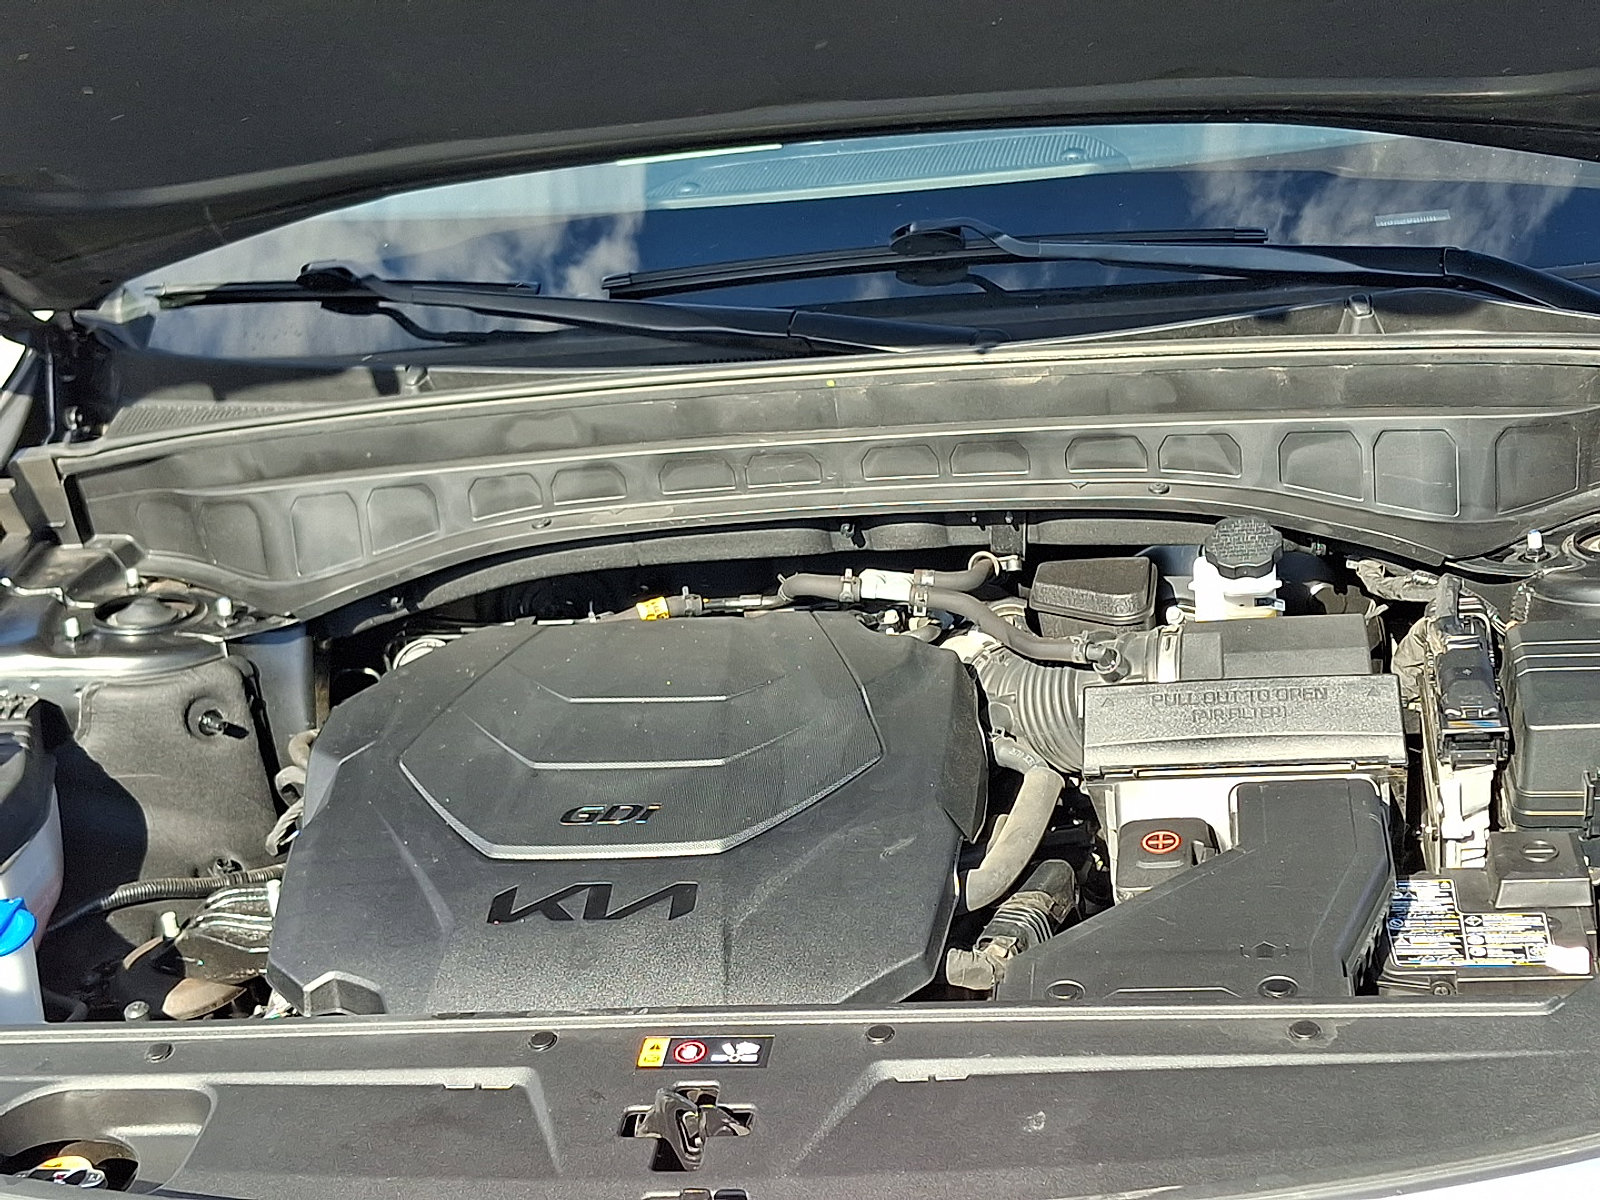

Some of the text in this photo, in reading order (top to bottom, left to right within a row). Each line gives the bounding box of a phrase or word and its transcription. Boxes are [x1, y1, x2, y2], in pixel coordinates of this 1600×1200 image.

[1151, 686, 1328, 707] PULL OUT TO OPEN
[486, 881, 699, 923] KIA
